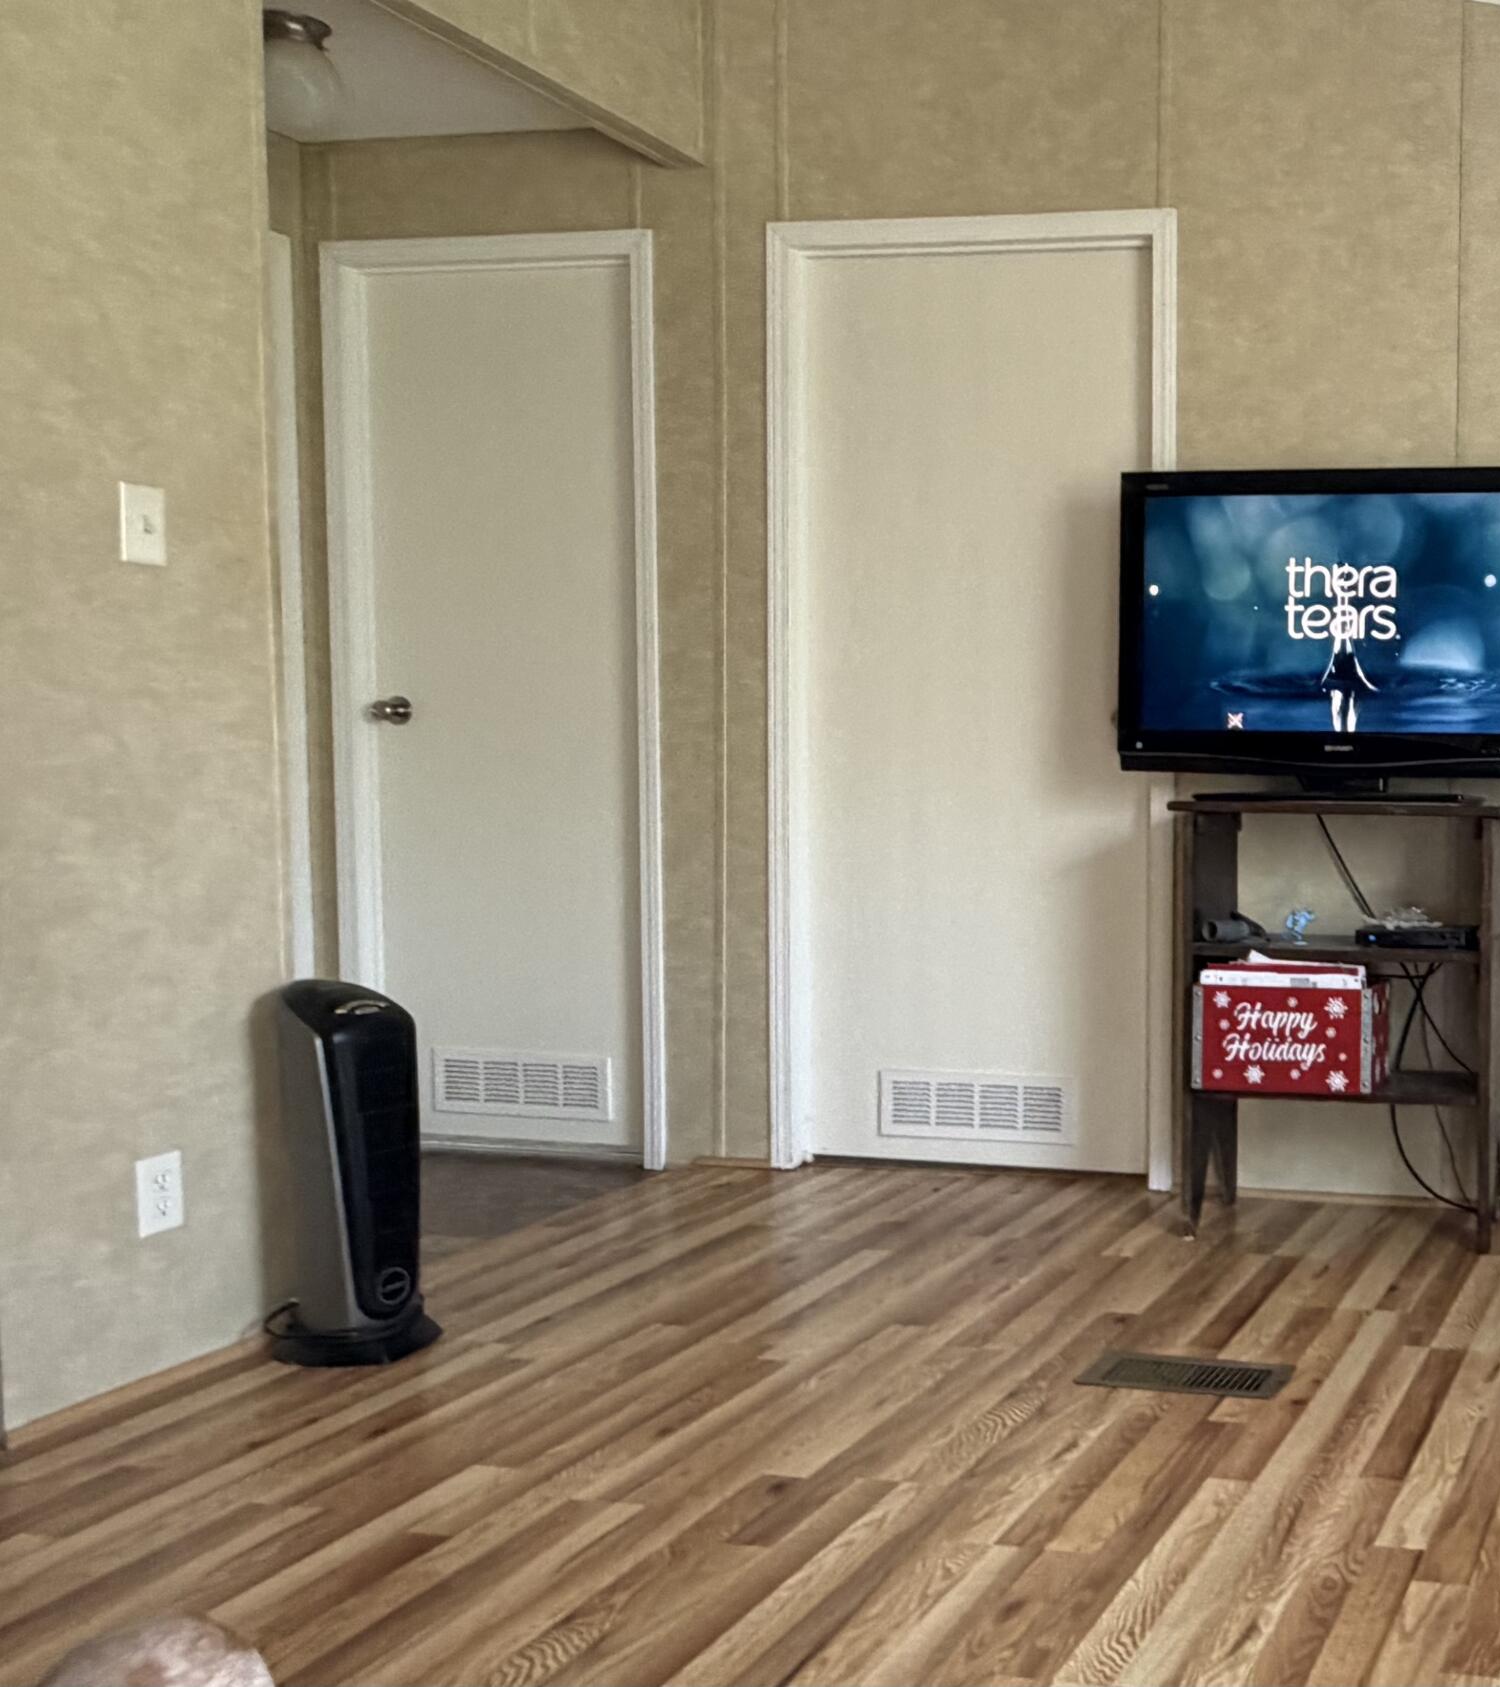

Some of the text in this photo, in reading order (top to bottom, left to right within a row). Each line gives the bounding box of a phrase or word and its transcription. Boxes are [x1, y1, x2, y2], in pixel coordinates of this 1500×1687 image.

[1285, 557, 1397, 598] thera
[1234, 1001, 1318, 1039] Happy
[1222, 1033, 1327, 1071] Holidays
